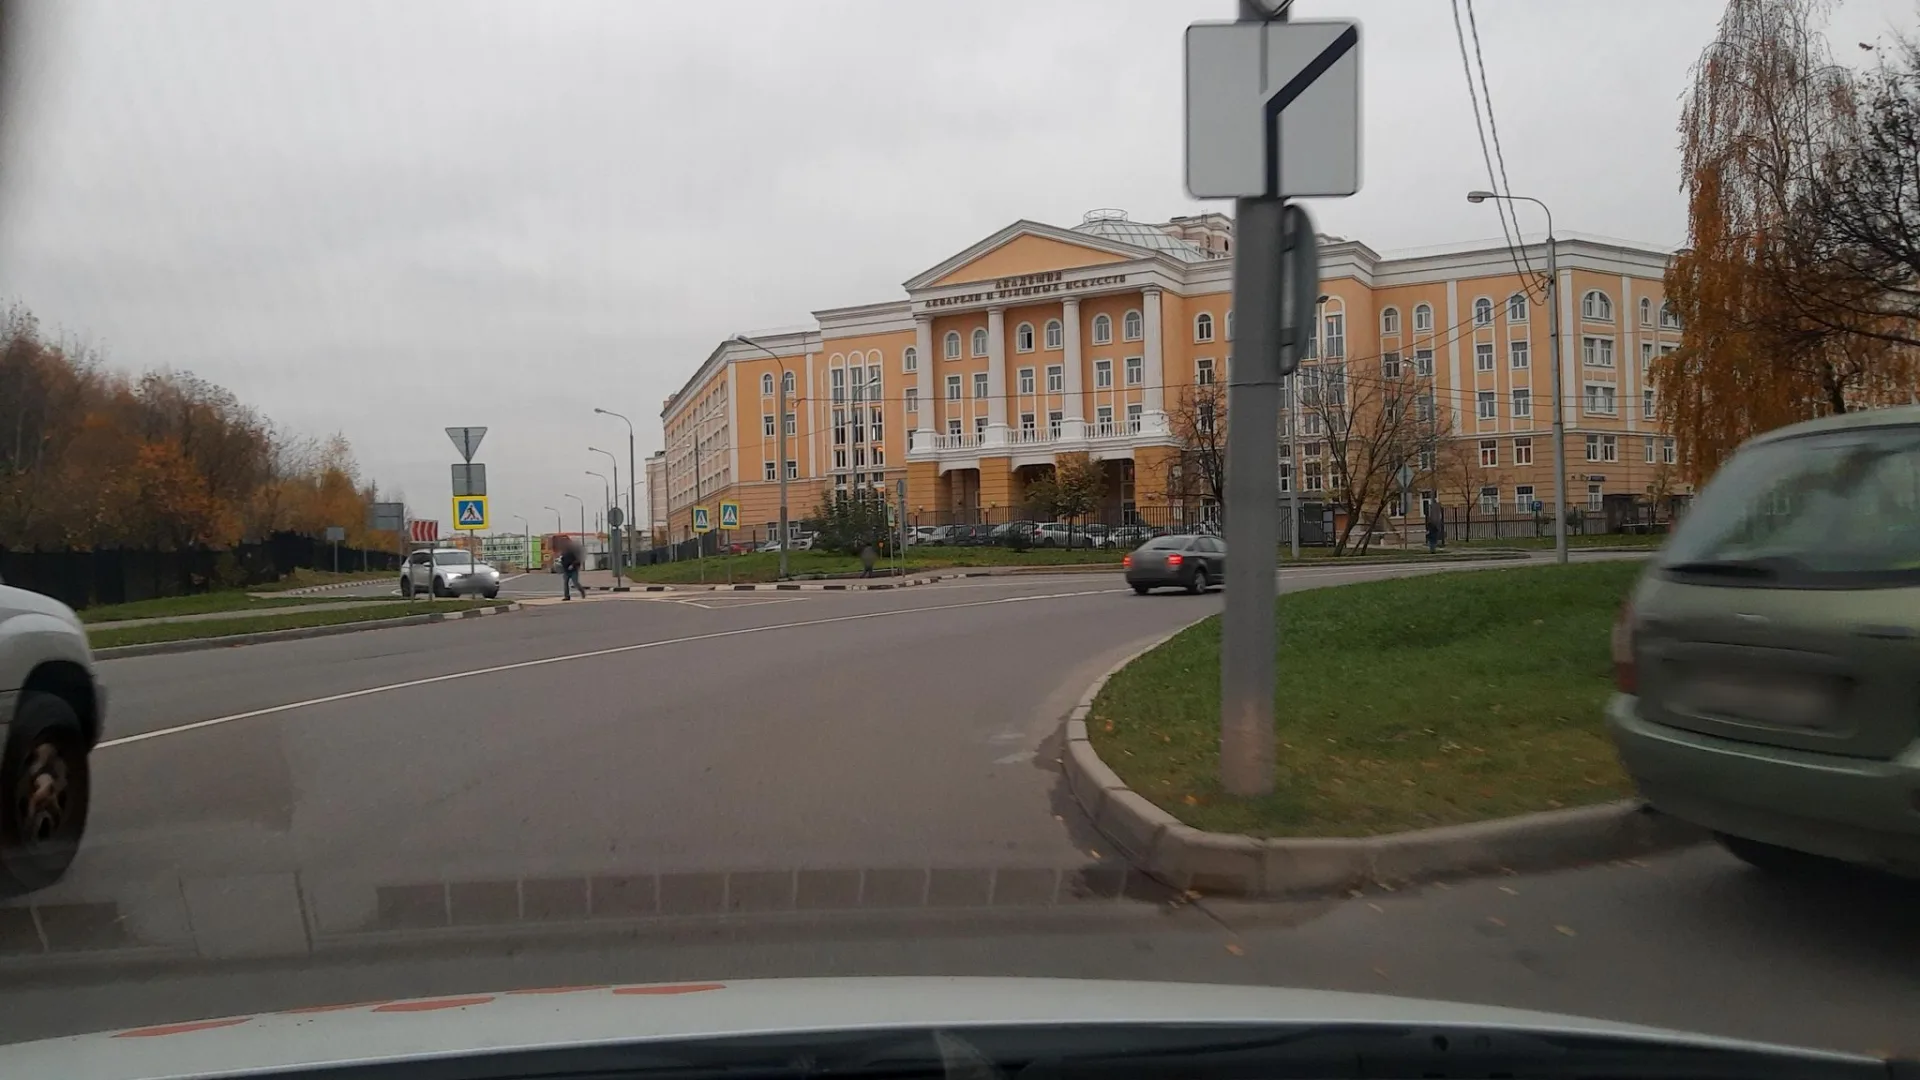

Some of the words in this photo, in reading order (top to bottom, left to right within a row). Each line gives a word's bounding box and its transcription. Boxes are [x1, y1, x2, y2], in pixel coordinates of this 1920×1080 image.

[925, 294, 981, 307] АКВАРЕЛИ
[1065, 274, 1126, 290] ИСКУССТВ
[995, 271, 1062, 289] АКАДЕМИЯ
